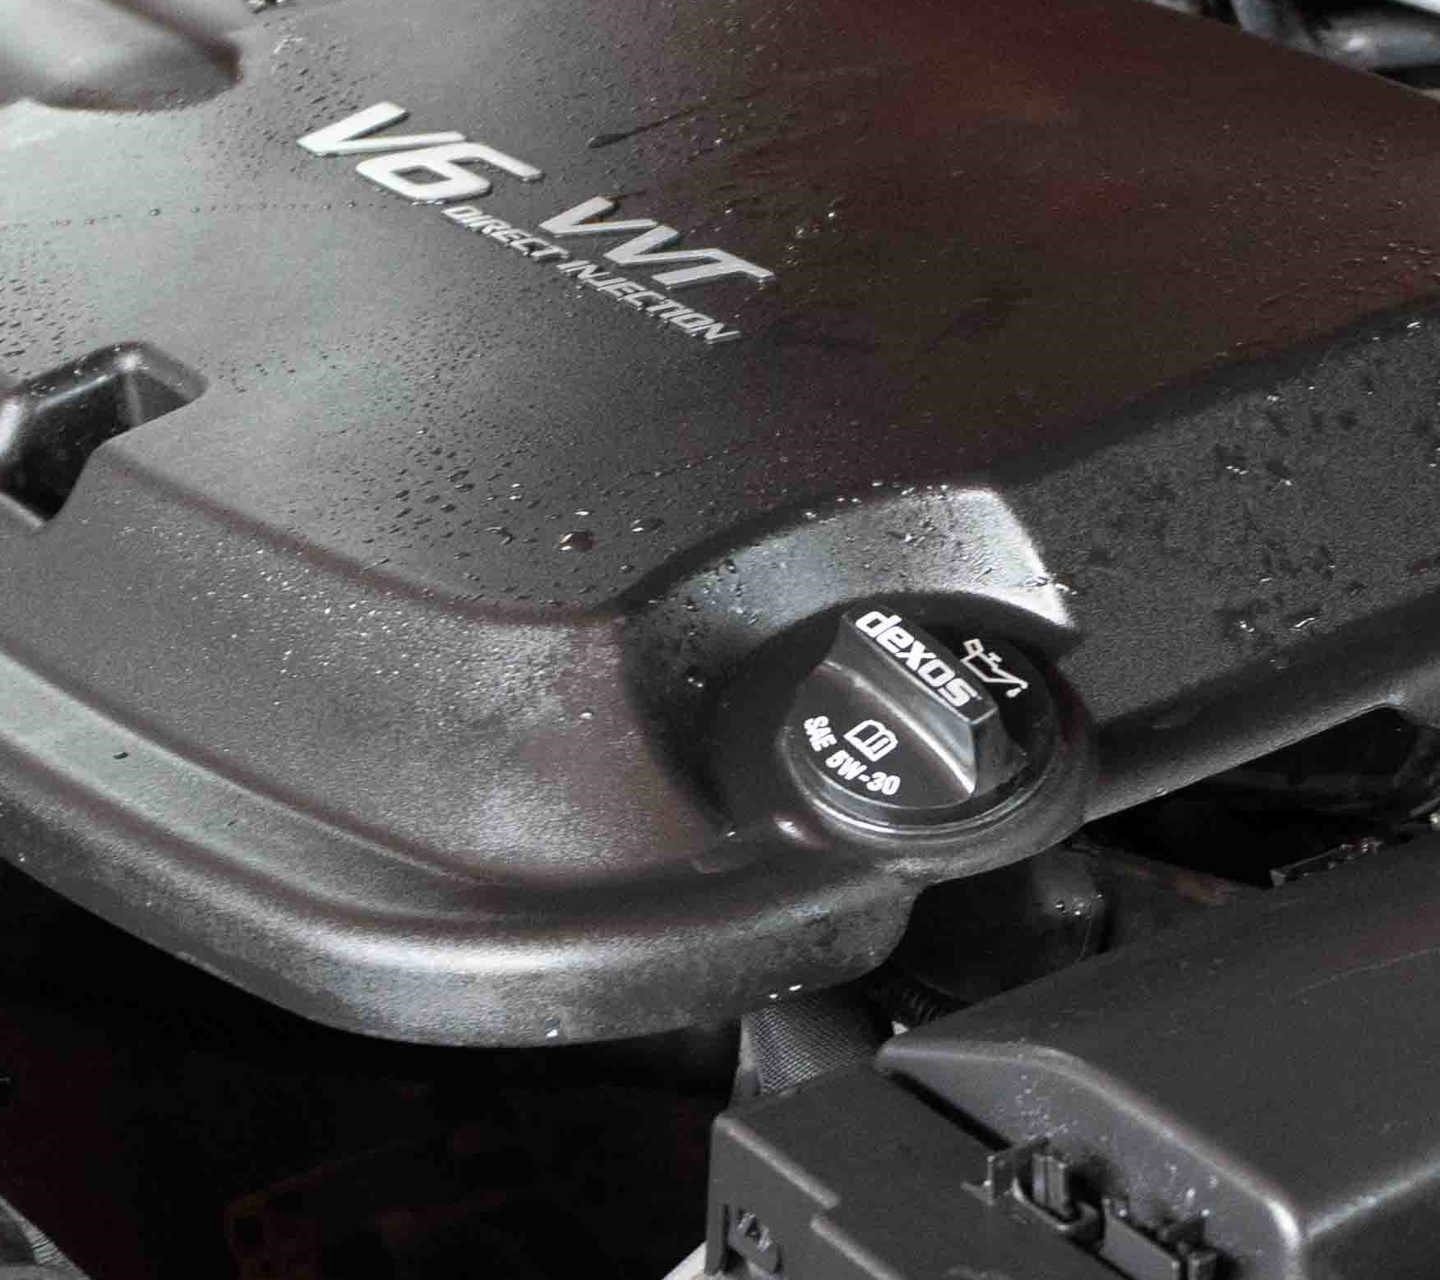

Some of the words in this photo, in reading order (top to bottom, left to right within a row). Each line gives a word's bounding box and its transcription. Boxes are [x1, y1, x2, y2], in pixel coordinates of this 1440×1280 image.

[296, 101, 542, 203] V6
[538, 196, 774, 286] VVT
[442, 204, 568, 260] DIRECT
[558, 258, 740, 344] INJECTION
[855, 610, 978, 706] dexos
[804, 716, 837, 751] SAE
[826, 750, 900, 795] 5W-30
